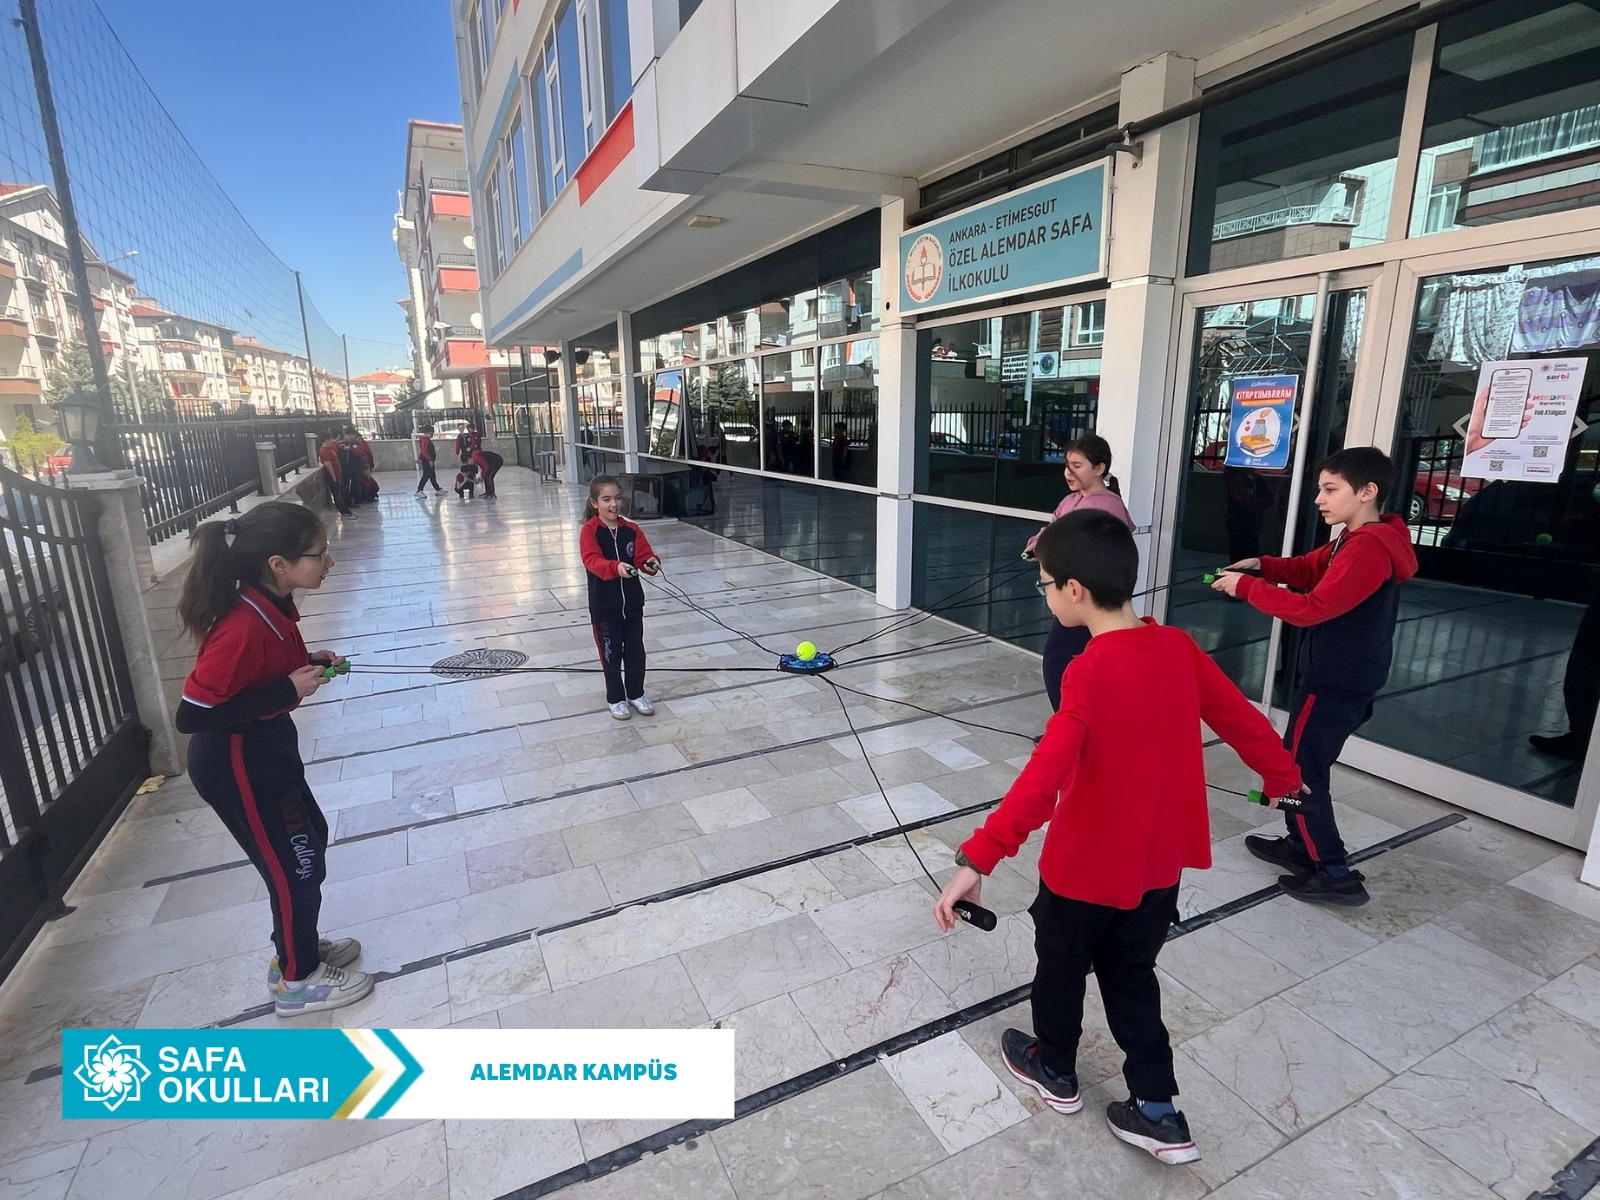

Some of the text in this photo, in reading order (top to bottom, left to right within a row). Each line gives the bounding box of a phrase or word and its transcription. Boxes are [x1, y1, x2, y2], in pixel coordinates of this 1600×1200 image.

[949, 246, 978, 268] ÖZEL
[981, 226, 1046, 260] ALEMDAR
[1051, 212, 1092, 240] SAFA
[950, 222, 987, 244] ANKARA
[996, 198, 1057, 231] ETİMESGUT
[948, 264, 1009, 292] İLKOKULU
